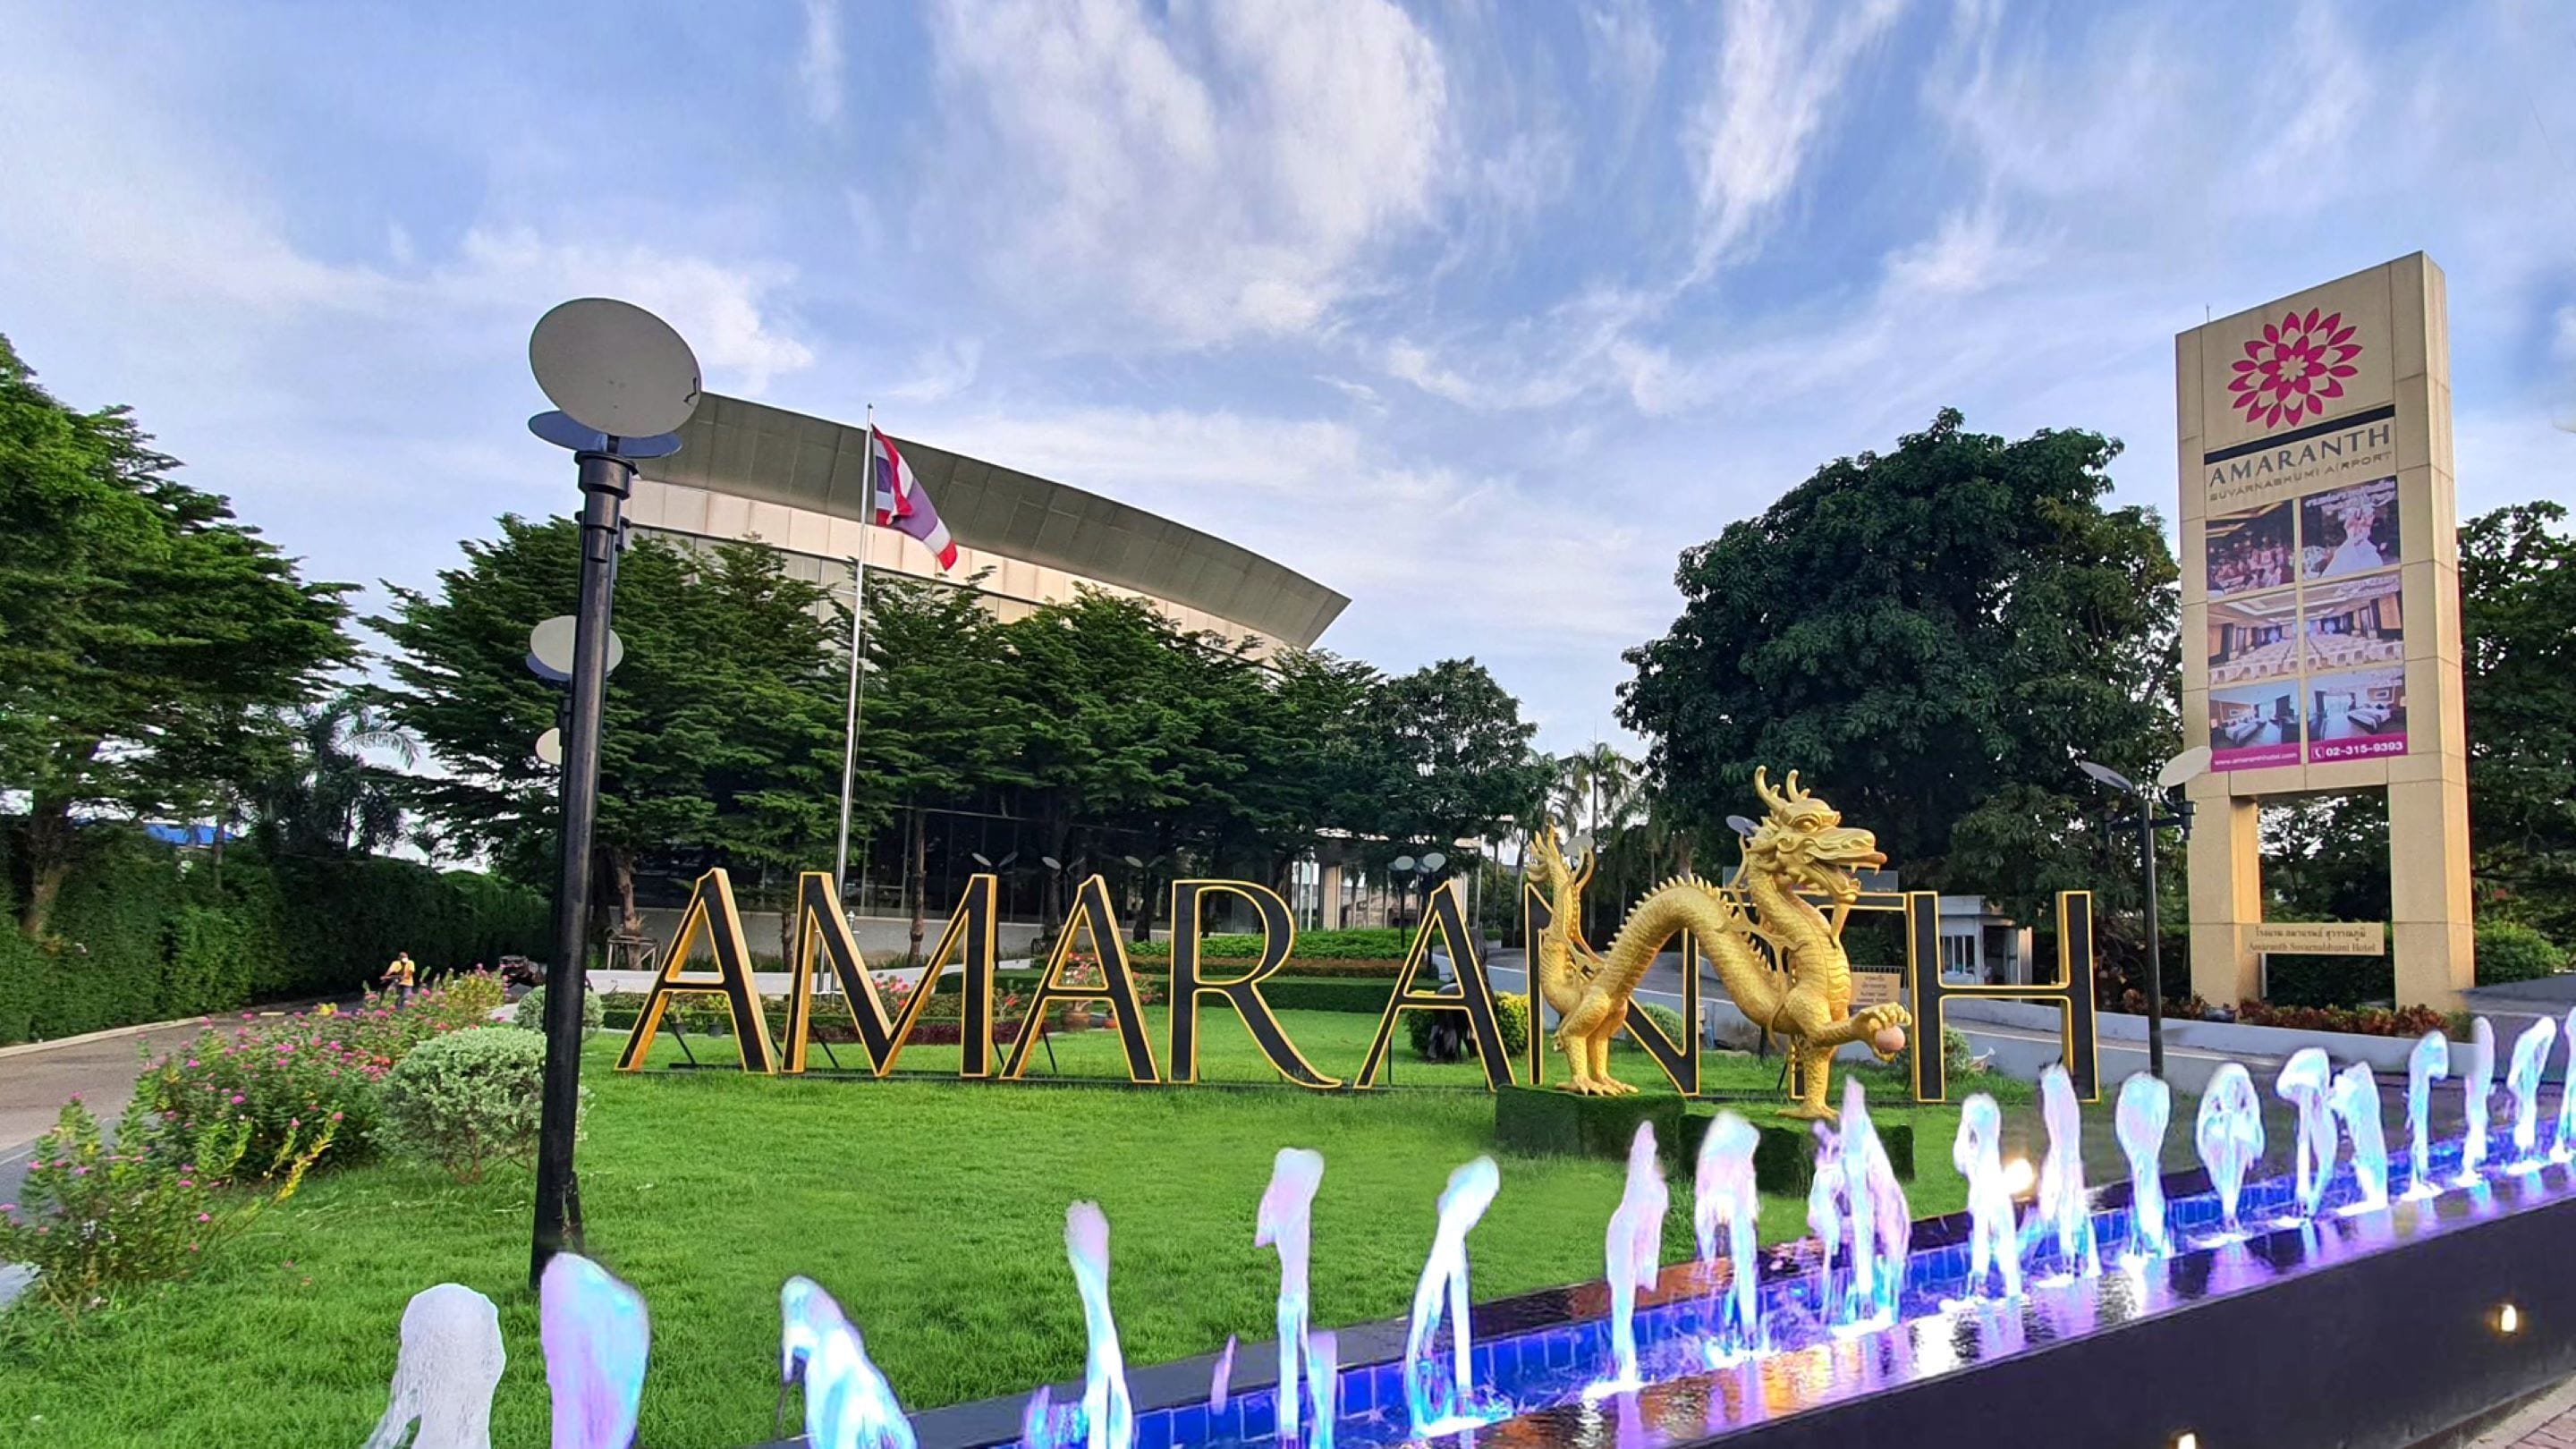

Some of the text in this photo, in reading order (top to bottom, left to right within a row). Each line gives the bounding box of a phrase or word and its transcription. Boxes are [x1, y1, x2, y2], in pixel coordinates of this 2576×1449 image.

[2209, 424, 2390, 487] AMARANTH
[2325, 450, 2393, 475] AIRPORT
[2352, 942, 2377, 952] Hotel
